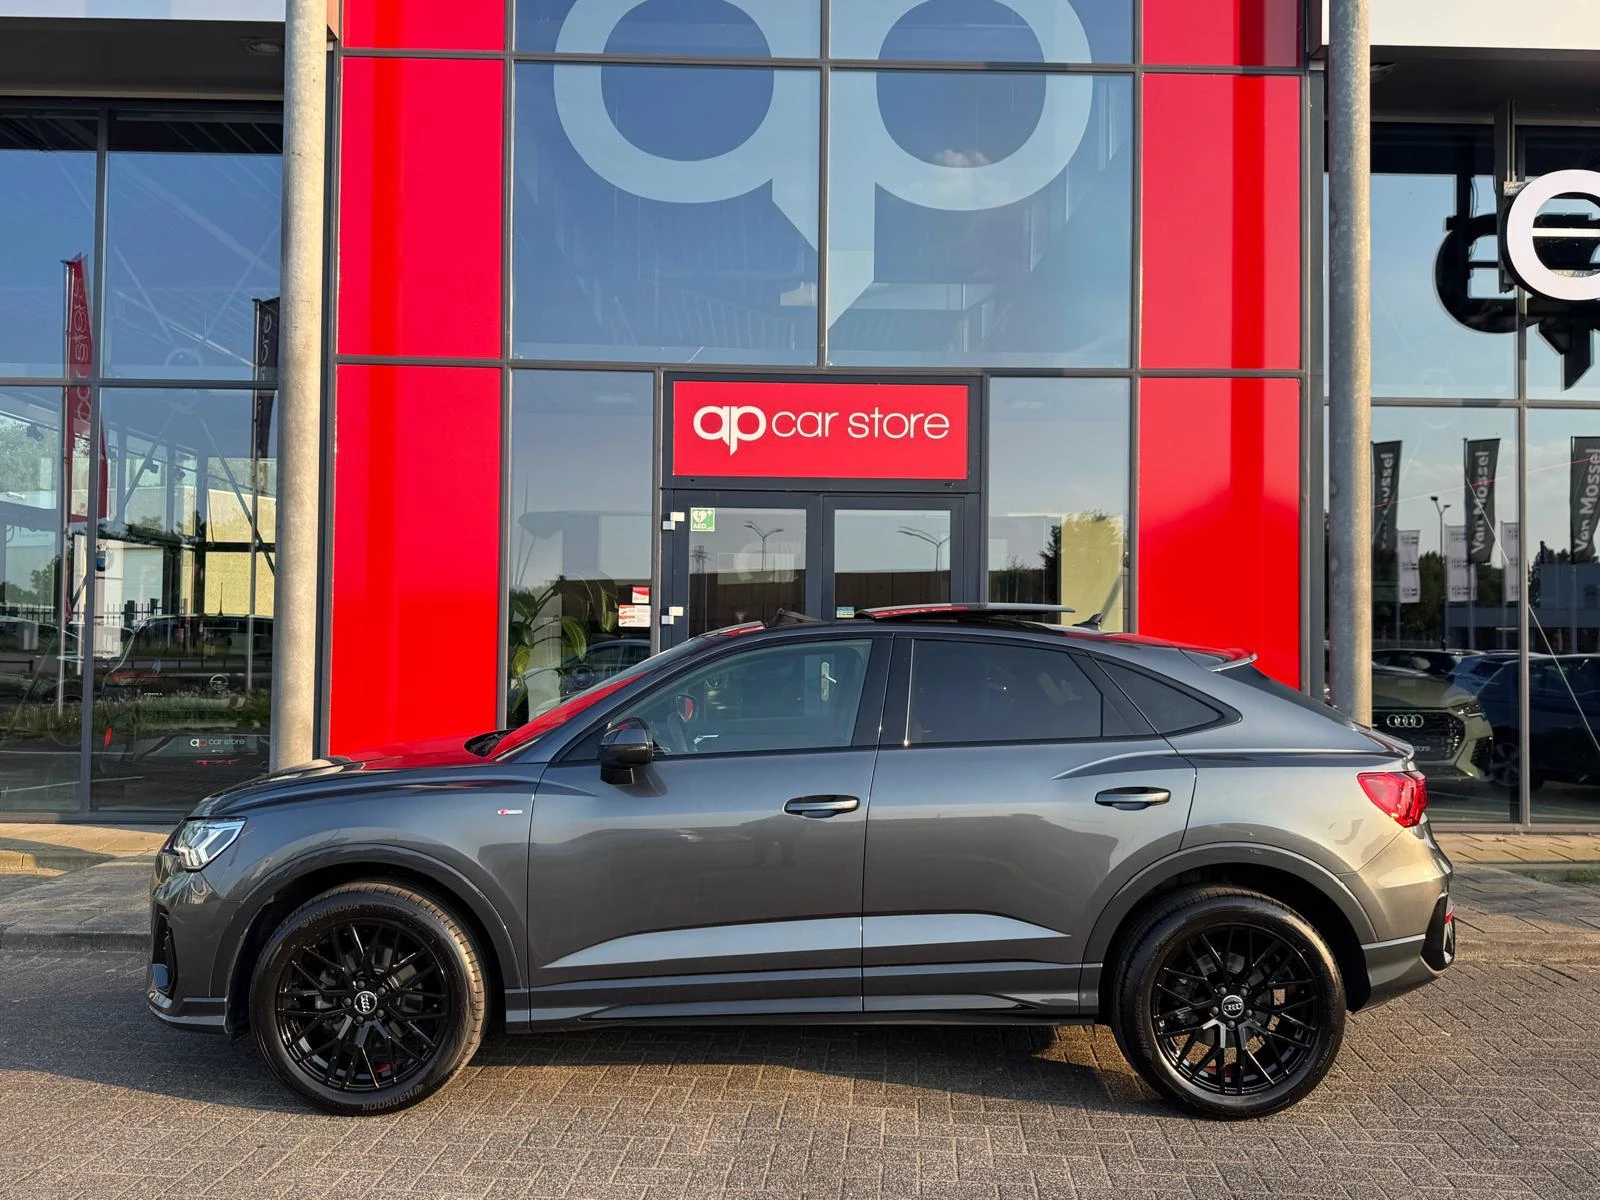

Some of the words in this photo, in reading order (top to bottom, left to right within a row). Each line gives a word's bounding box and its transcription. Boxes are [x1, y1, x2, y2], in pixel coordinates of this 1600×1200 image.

[693, 405, 767, 456] ap
[771, 411, 839, 438] car
[847, 407, 950, 439] store
[1472, 451, 1490, 515] Mossel
[1580, 448, 1600, 515] Mossel
[1471, 520, 1486, 554] Van
[1574, 519, 1590, 553] Van
